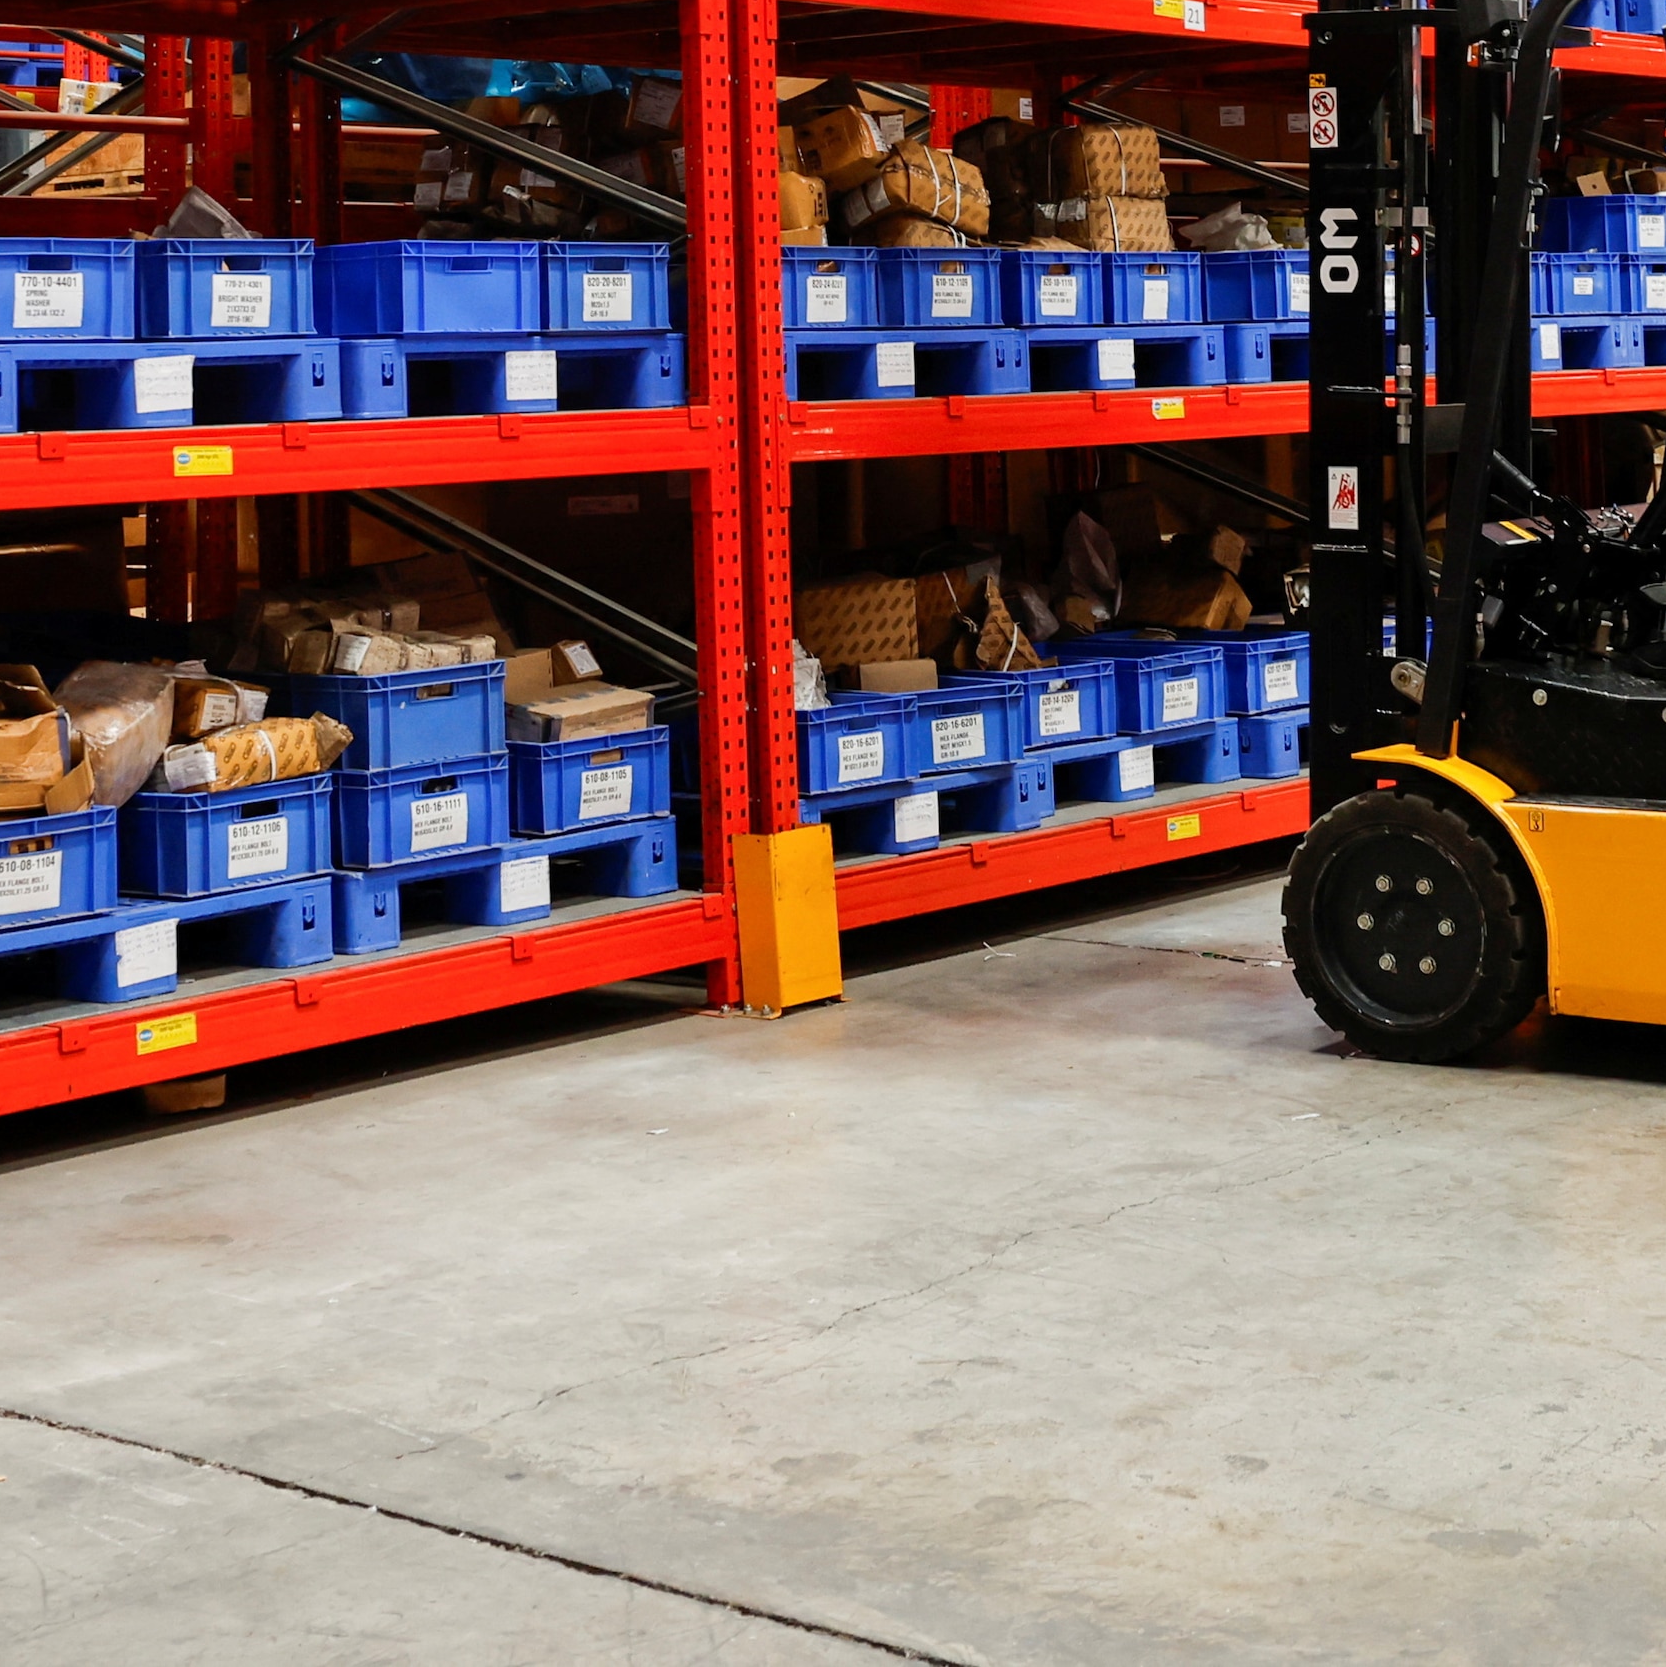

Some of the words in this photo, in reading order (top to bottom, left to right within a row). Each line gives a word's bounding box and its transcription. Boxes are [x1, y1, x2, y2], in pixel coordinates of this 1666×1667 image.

[1188, 8, 1200, 24] 21
[1320, 207, 1359, 294] OM
[21, 276, 77, 288] 770-10-4401
[218, 295, 239, 303] BRIGHT
[241, 295, 263, 303] WASHER
[935, 717, 978, 733] 820-16-6201
[585, 769, 628, 785] 610-08-1105
[415, 798, 462, 816] 610-16-1111
[232, 821, 282, 839] 610-12-1106
